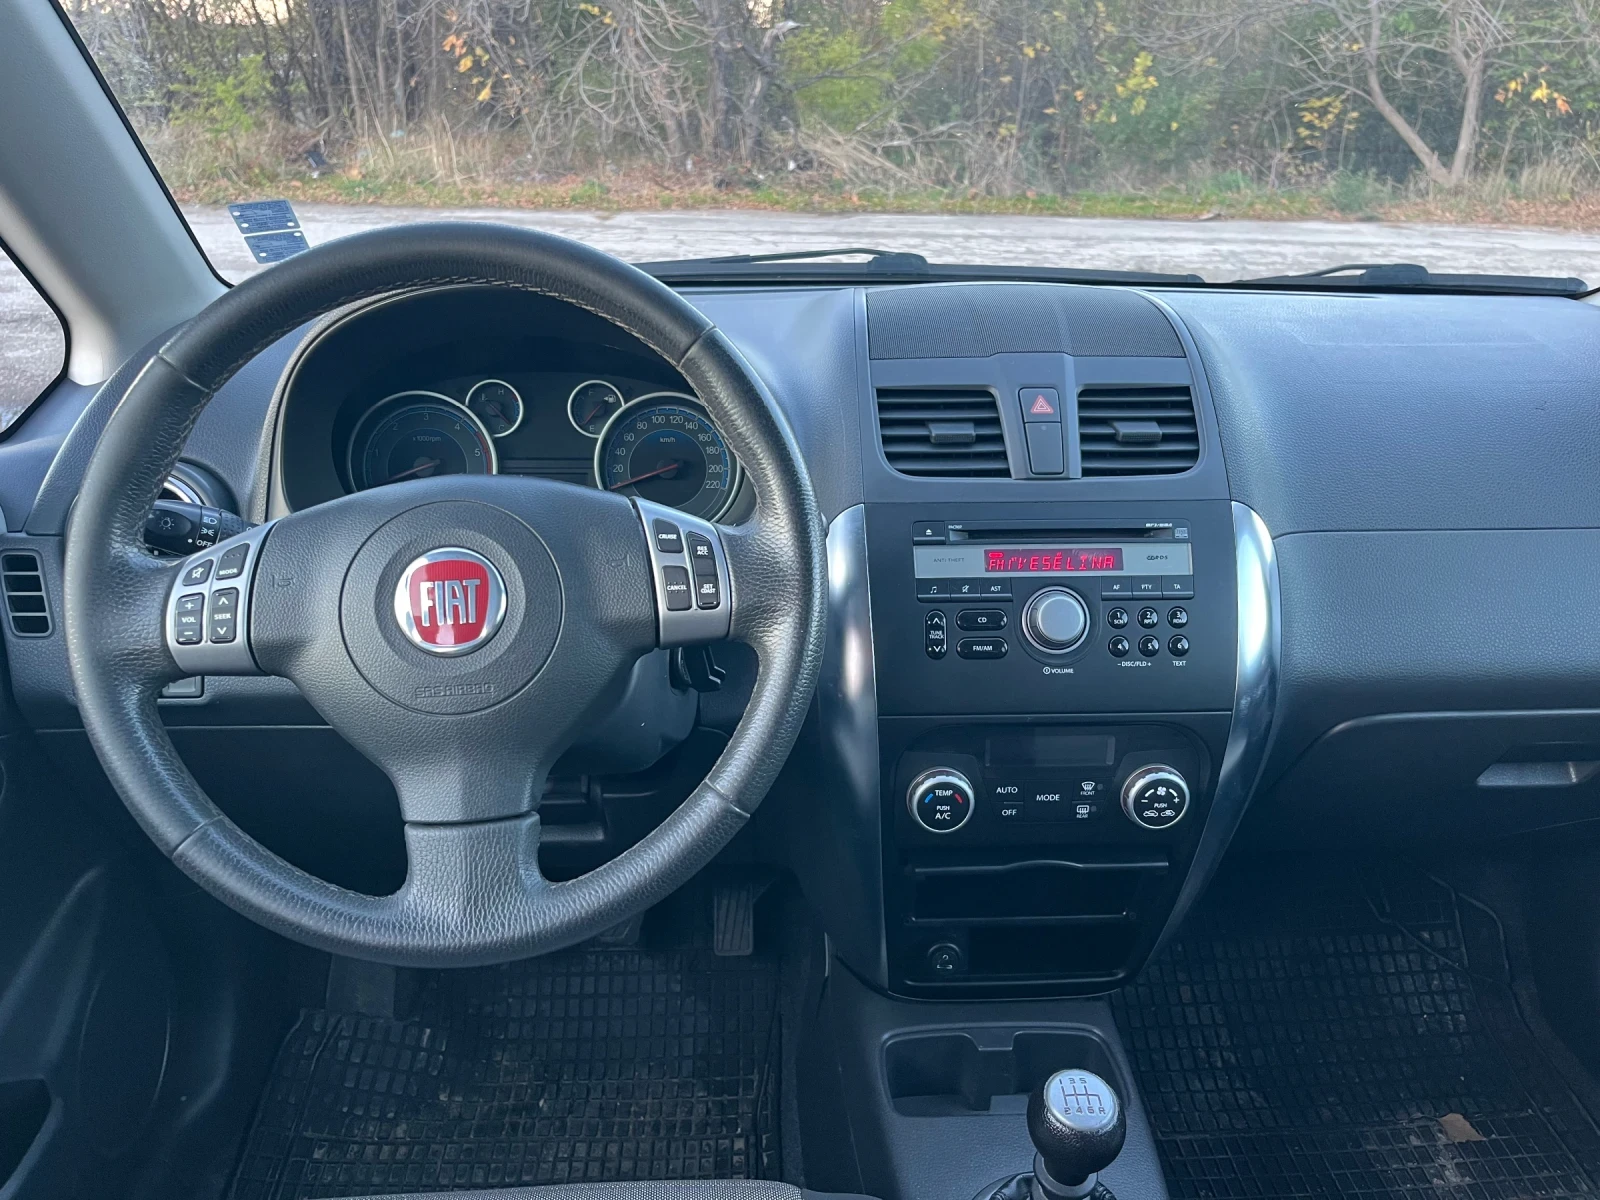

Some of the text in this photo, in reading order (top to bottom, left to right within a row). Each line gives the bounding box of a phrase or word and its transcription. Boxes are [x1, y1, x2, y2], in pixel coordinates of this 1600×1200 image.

[423, 412, 429, 421] 3
[651, 415, 666, 424] 100
[669, 415, 684, 424] 120
[454, 422, 461, 430] 4
[636, 421, 648, 430] 80
[684, 422, 698, 430] 140
[623, 432, 635, 442] 60
[698, 433, 712, 442] 160
[474, 448, 481, 457] 5
[614, 447, 626, 456] 40
[706, 446, 720, 455] 180
[612, 464, 624, 473] 20
[708, 464, 724, 473] 200
[706, 480, 720, 489] 220
[196, 540, 214, 548] OFF
[419, 578, 481, 627] FIAT
[214, 612, 232, 620] SEEK
[996, 786, 1018, 794] AUTO
[1036, 794, 1060, 802] MODE
[934, 812, 952, 820] A/C
[1001, 808, 1018, 816] OFF
[1064, 1106, 1106, 1115] 2 4 6 R
